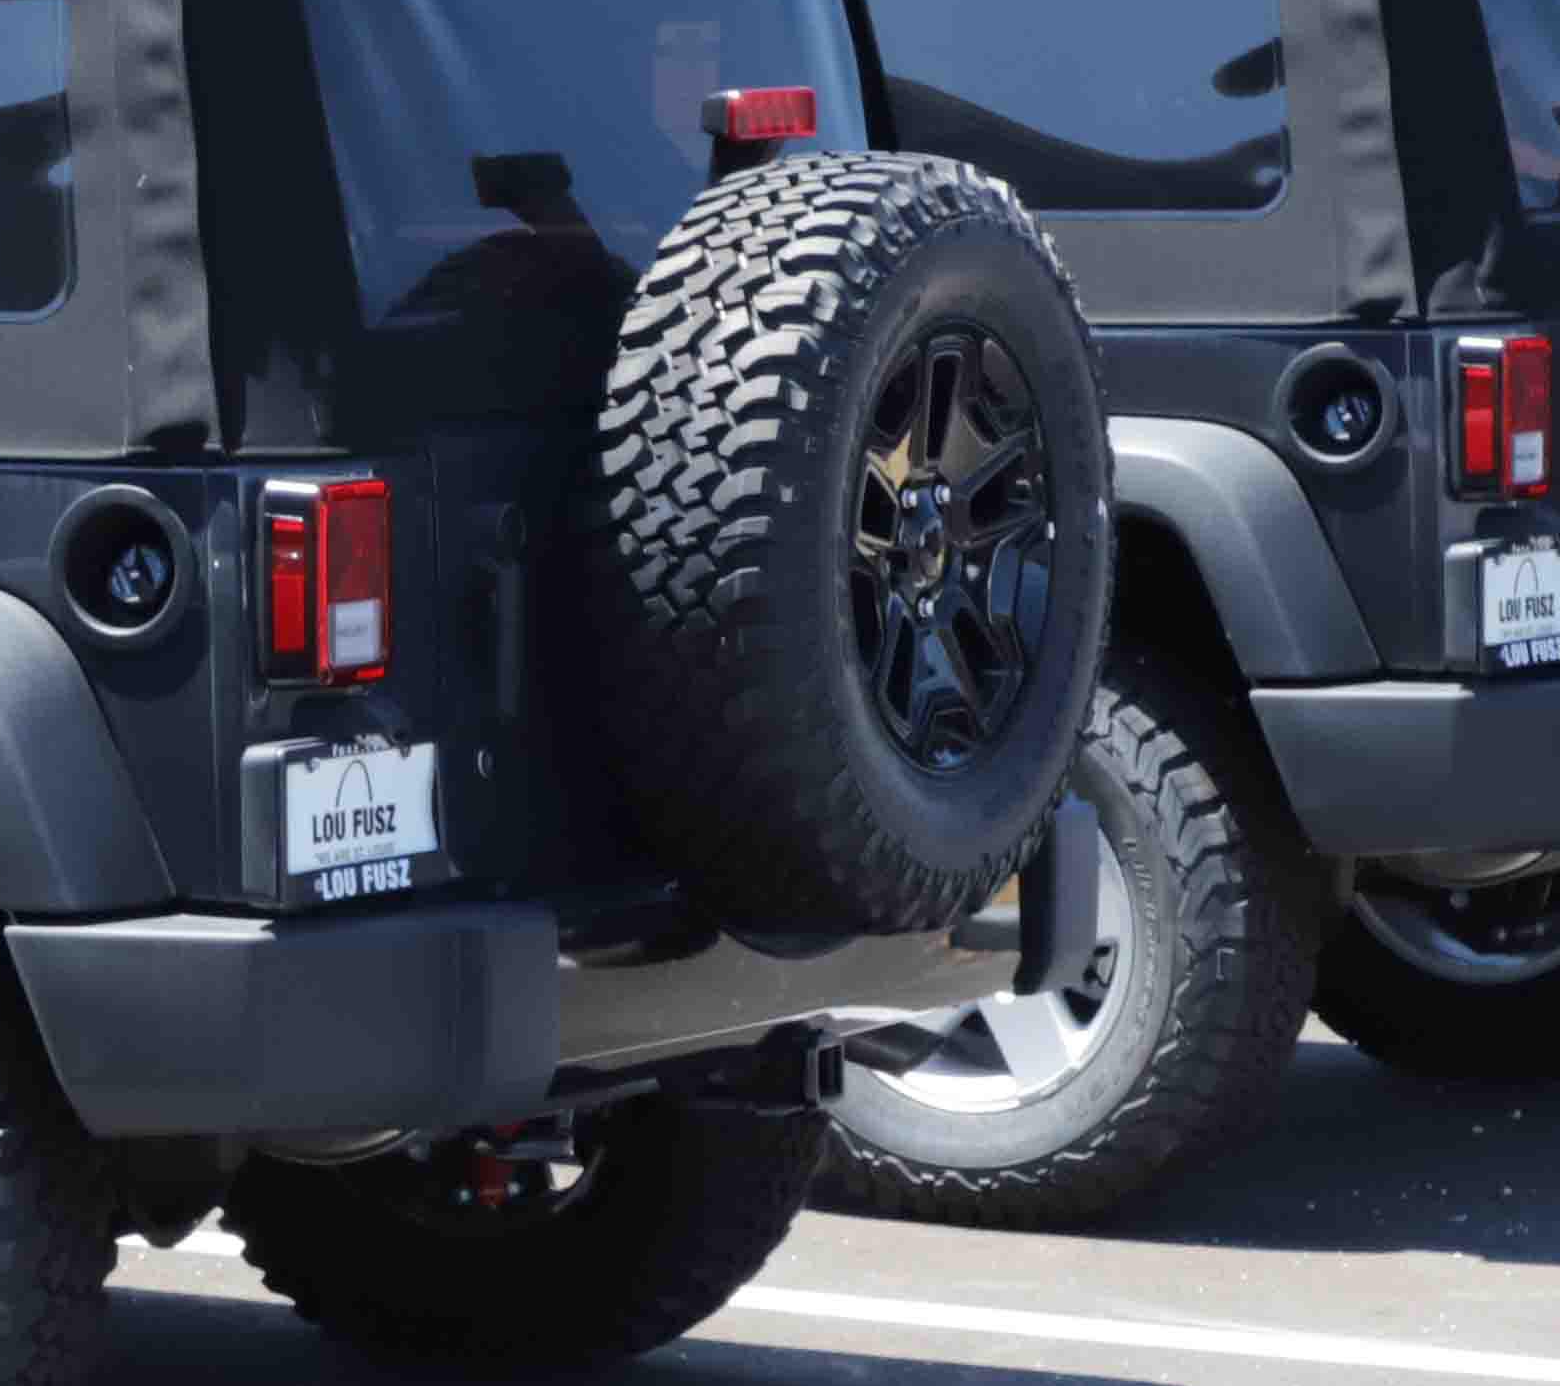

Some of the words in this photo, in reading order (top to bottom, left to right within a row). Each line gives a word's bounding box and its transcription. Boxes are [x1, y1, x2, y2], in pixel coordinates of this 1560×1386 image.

[312, 811, 346, 845] LOU
[353, 804, 397, 838] FUSZ
[321, 866, 357, 901] LOU
[362, 858, 412, 894] FUSZ
